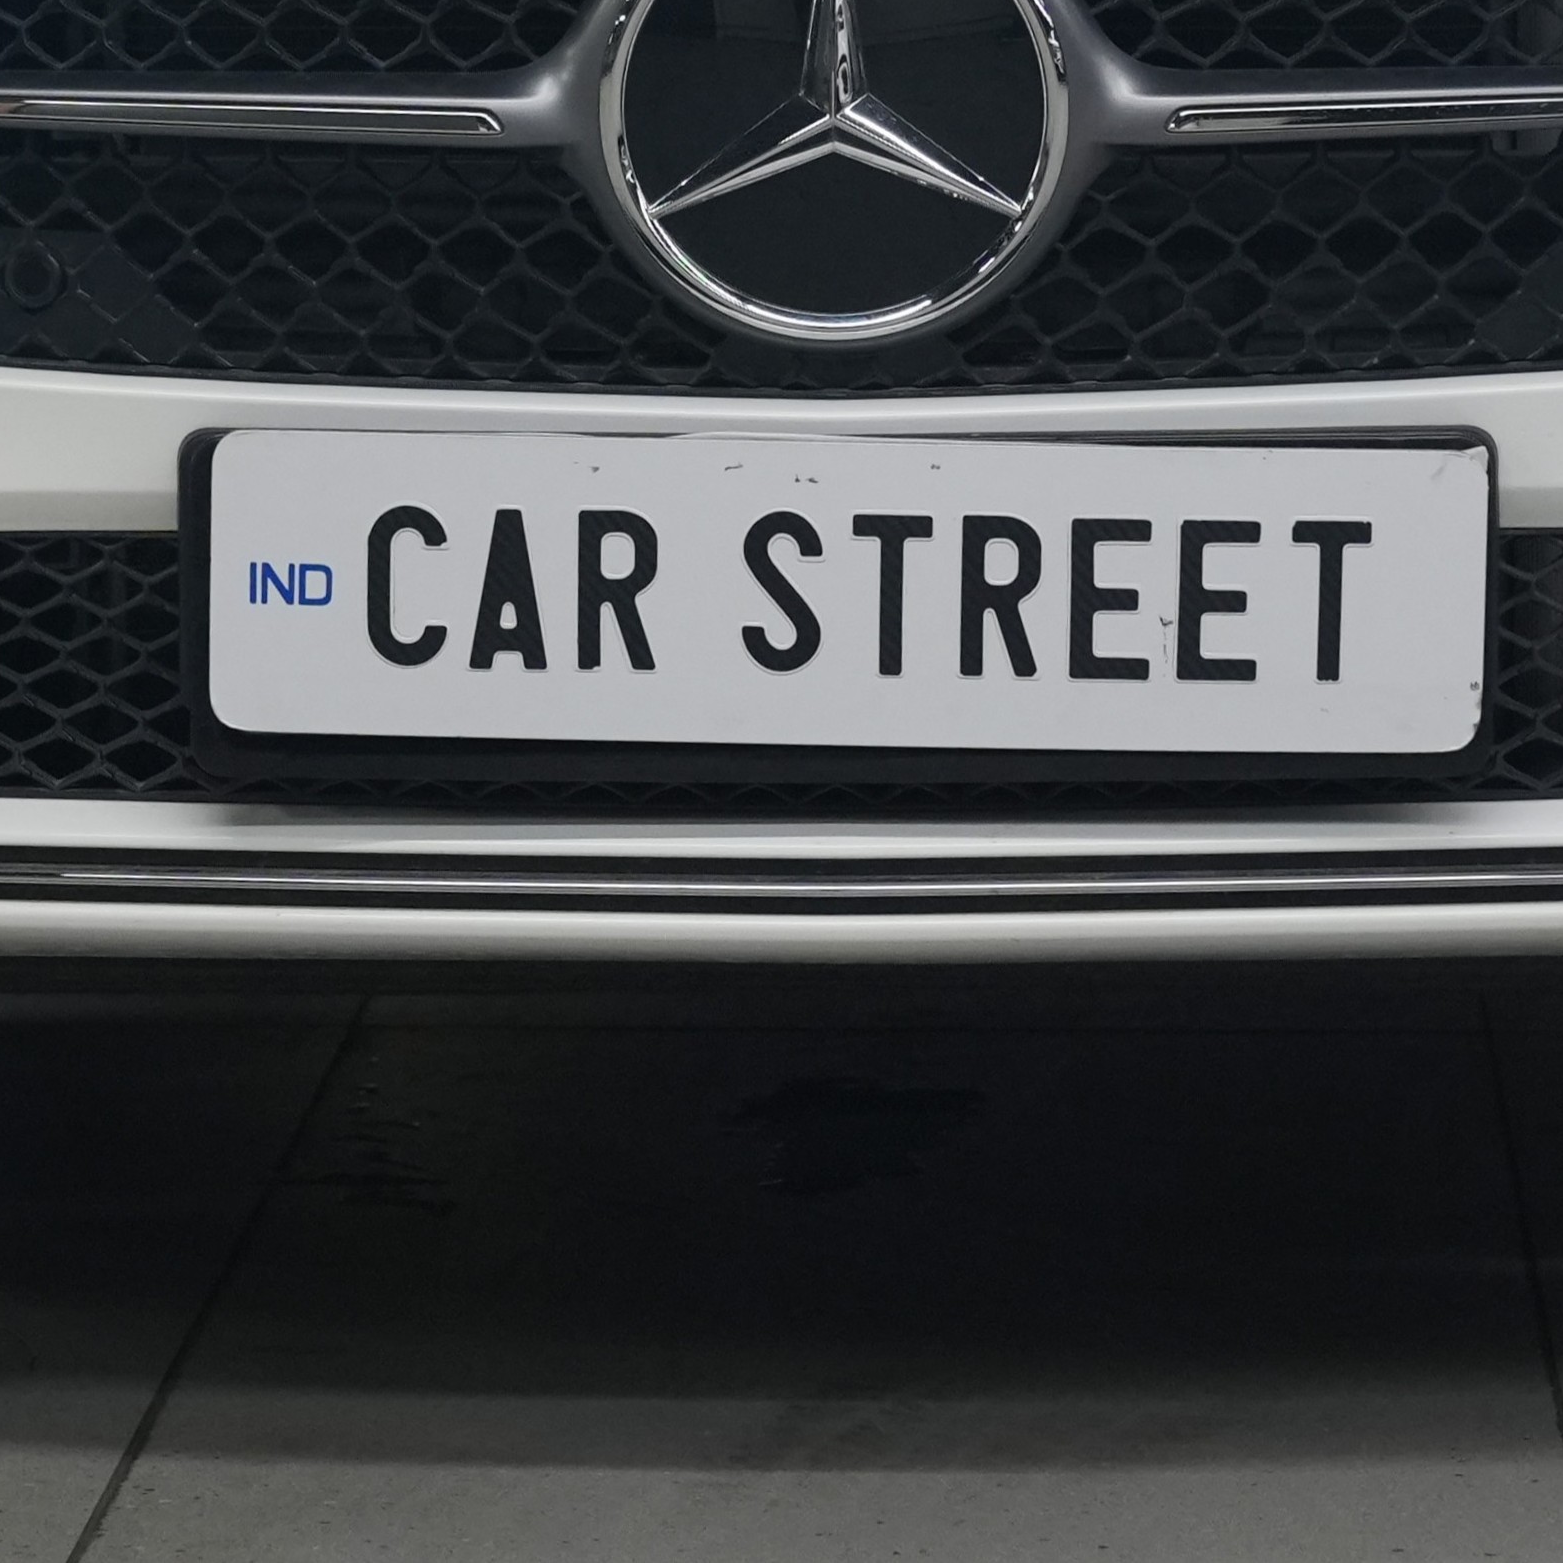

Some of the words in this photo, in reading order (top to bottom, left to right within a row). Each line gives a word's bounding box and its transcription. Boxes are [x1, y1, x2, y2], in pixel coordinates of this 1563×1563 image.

[248, 561, 334, 606] IND
[366, 504, 659, 672] CAR
[740, 509, 1373, 683] STREET
